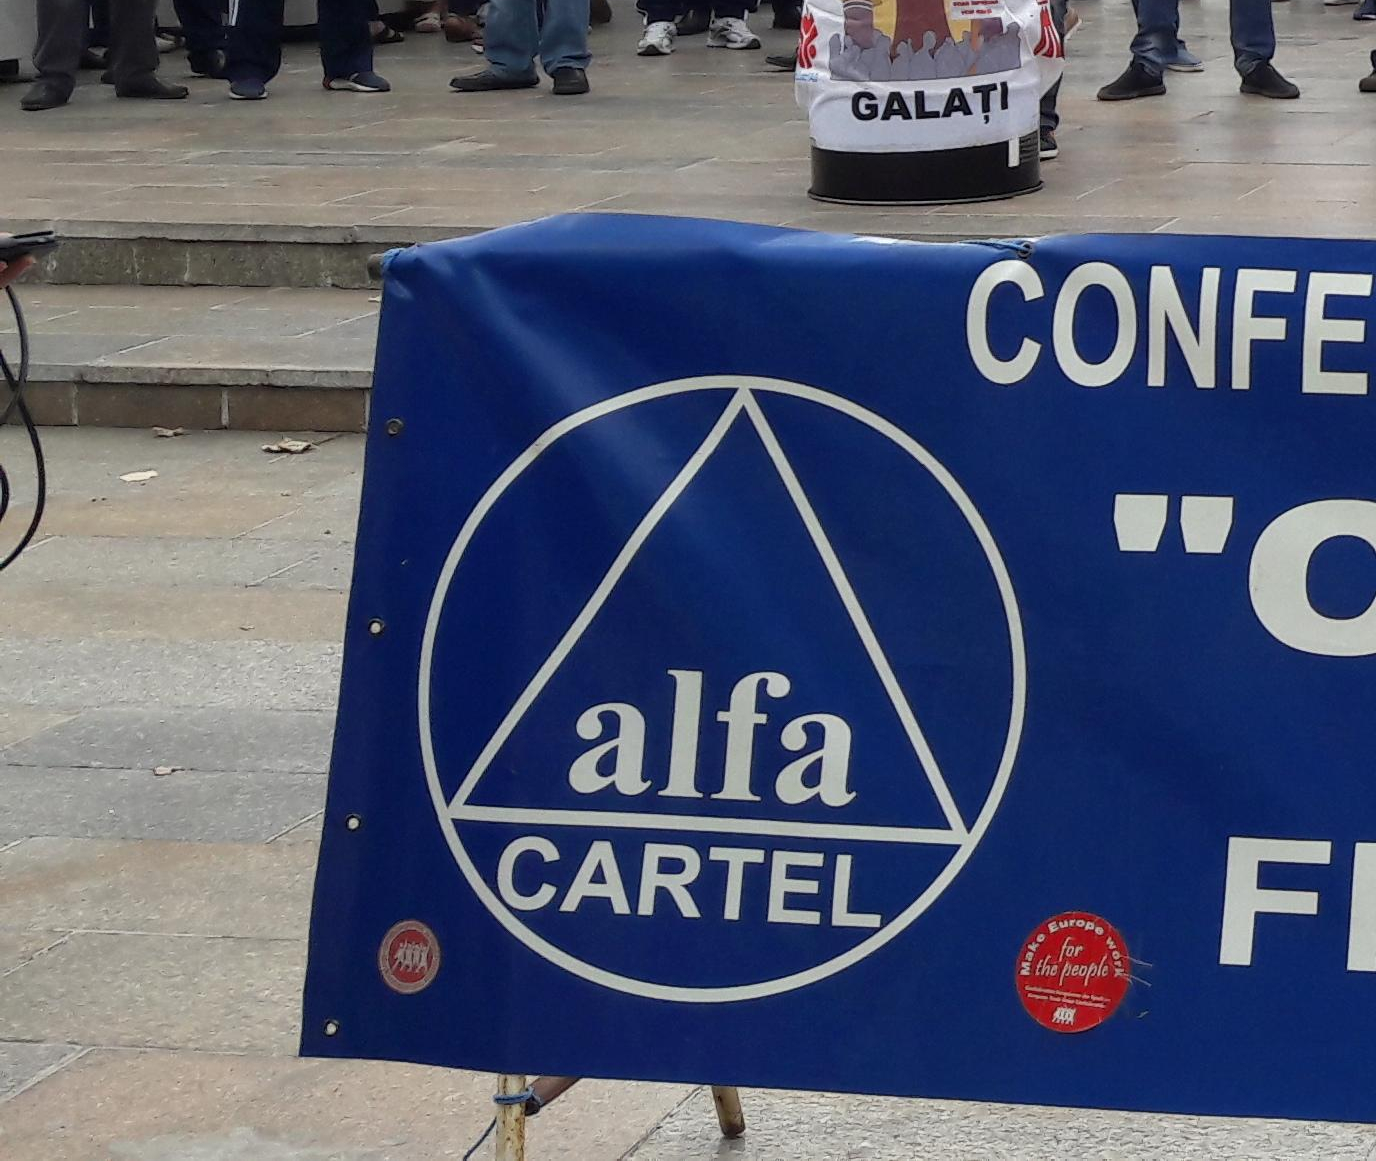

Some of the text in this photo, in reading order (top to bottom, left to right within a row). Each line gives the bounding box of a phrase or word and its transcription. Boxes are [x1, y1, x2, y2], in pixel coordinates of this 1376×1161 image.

[851, 81, 1009, 125] GALAȚI
[569, 670, 856, 807] alfa
[496, 837, 884, 930] CARTEL
[1020, 919, 1125, 978] Make Europe work
[1035, 954, 1109, 987] the people
[1059, 936, 1084, 962] for
